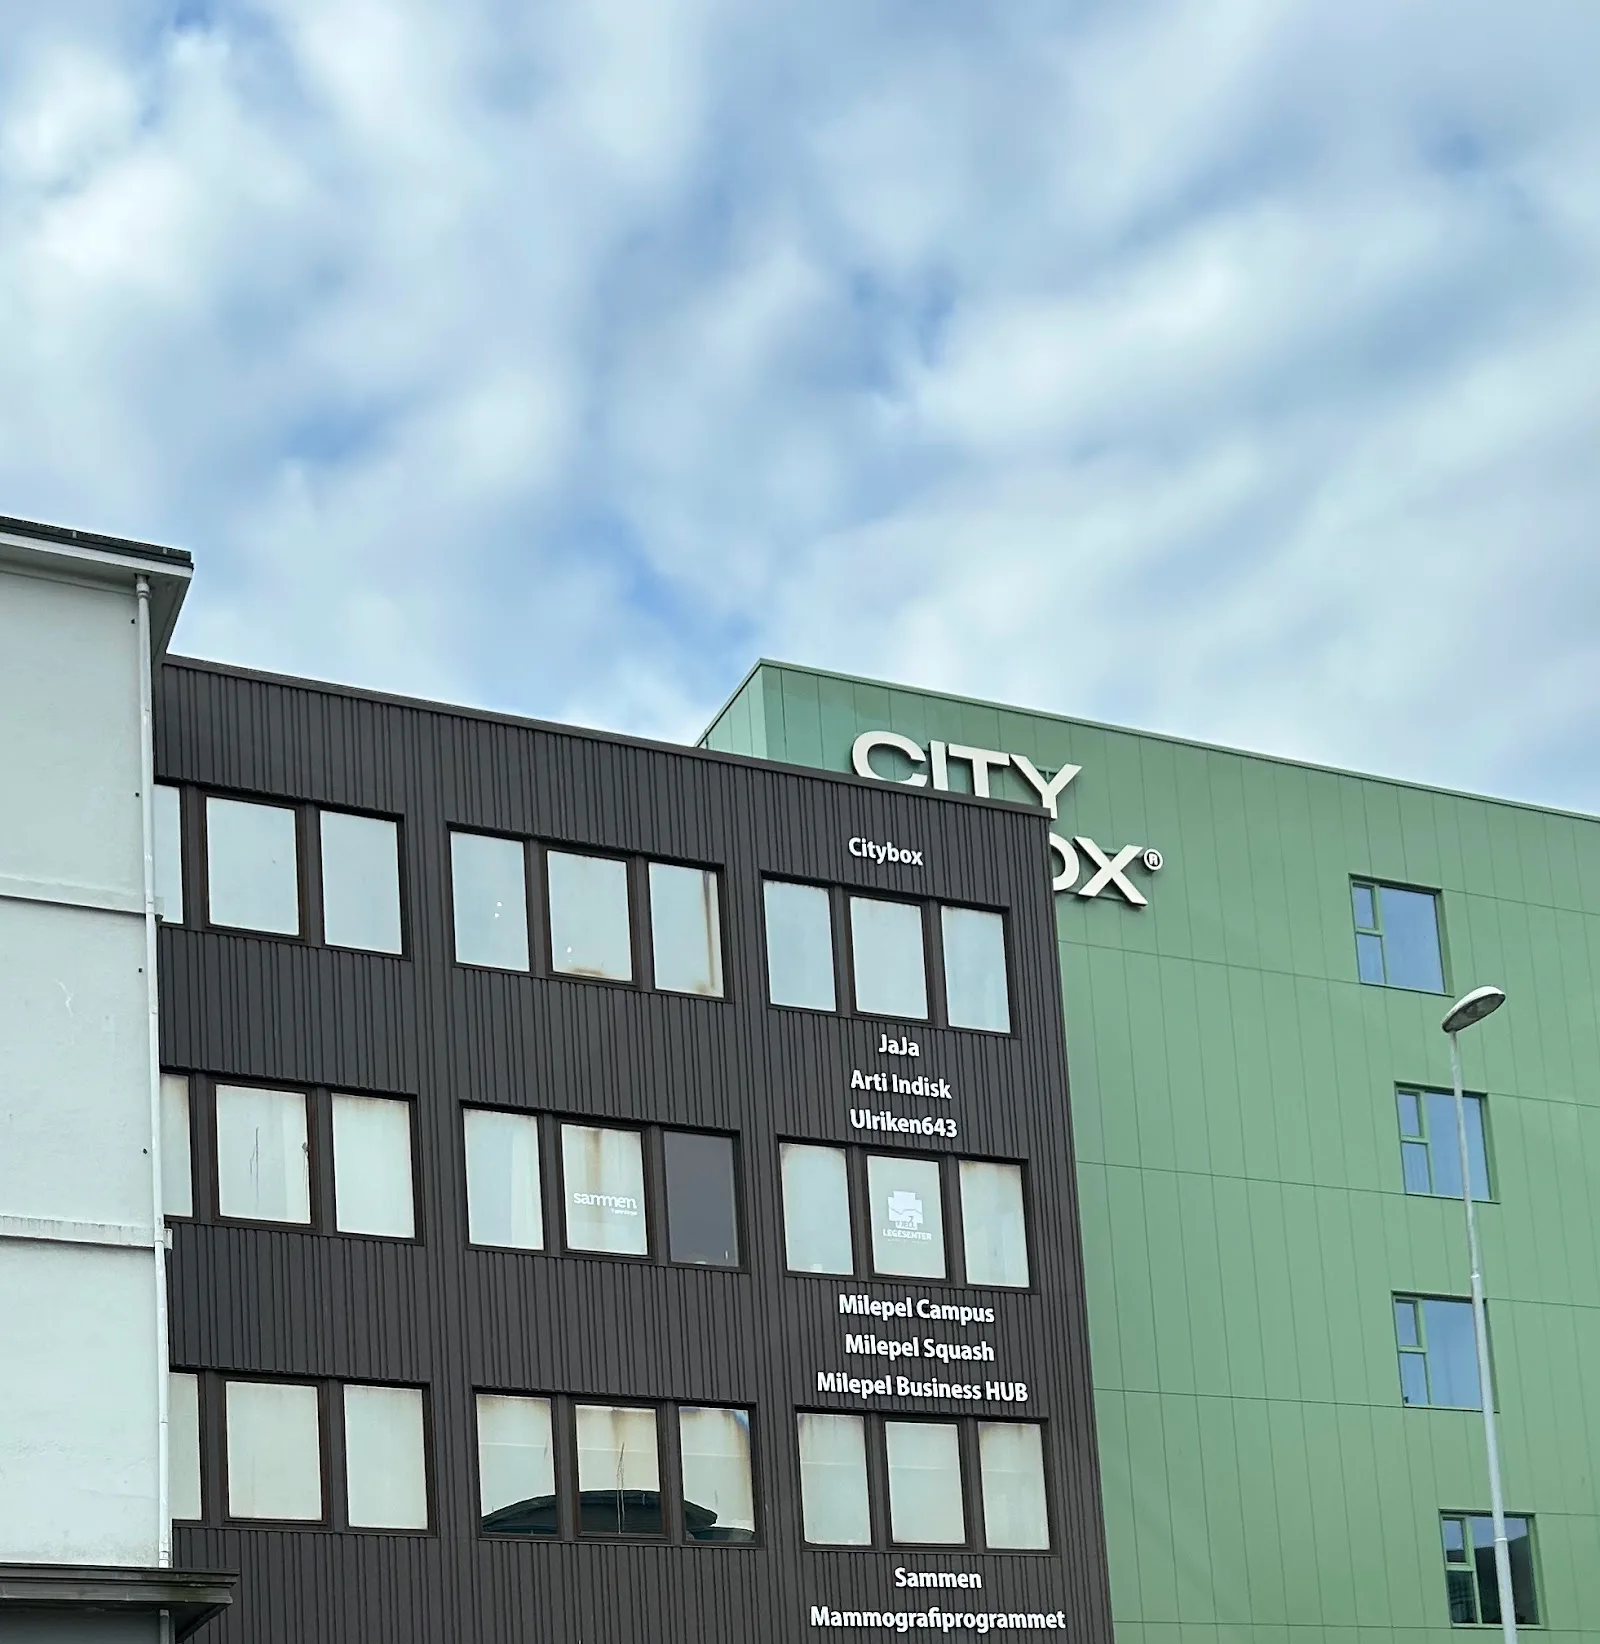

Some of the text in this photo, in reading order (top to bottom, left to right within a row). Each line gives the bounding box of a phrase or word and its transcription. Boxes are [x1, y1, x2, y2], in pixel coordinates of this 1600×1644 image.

[852, 730, 1082, 819] CITY
[848, 837, 924, 866] Citybox
[878, 1033, 920, 1057] JaJa
[850, 1069, 953, 1099] Arti Indisk
[849, 1108, 958, 1138] Ulriken643
[839, 1293, 995, 1326] Milepel Campus
[845, 1333, 995, 1364] Milepel Squash
[817, 1371, 1029, 1402] Milepel Business HUB
[894, 1566, 983, 1589] Sammen
[810, 1605, 1066, 1634] Mammografiprogrammet
